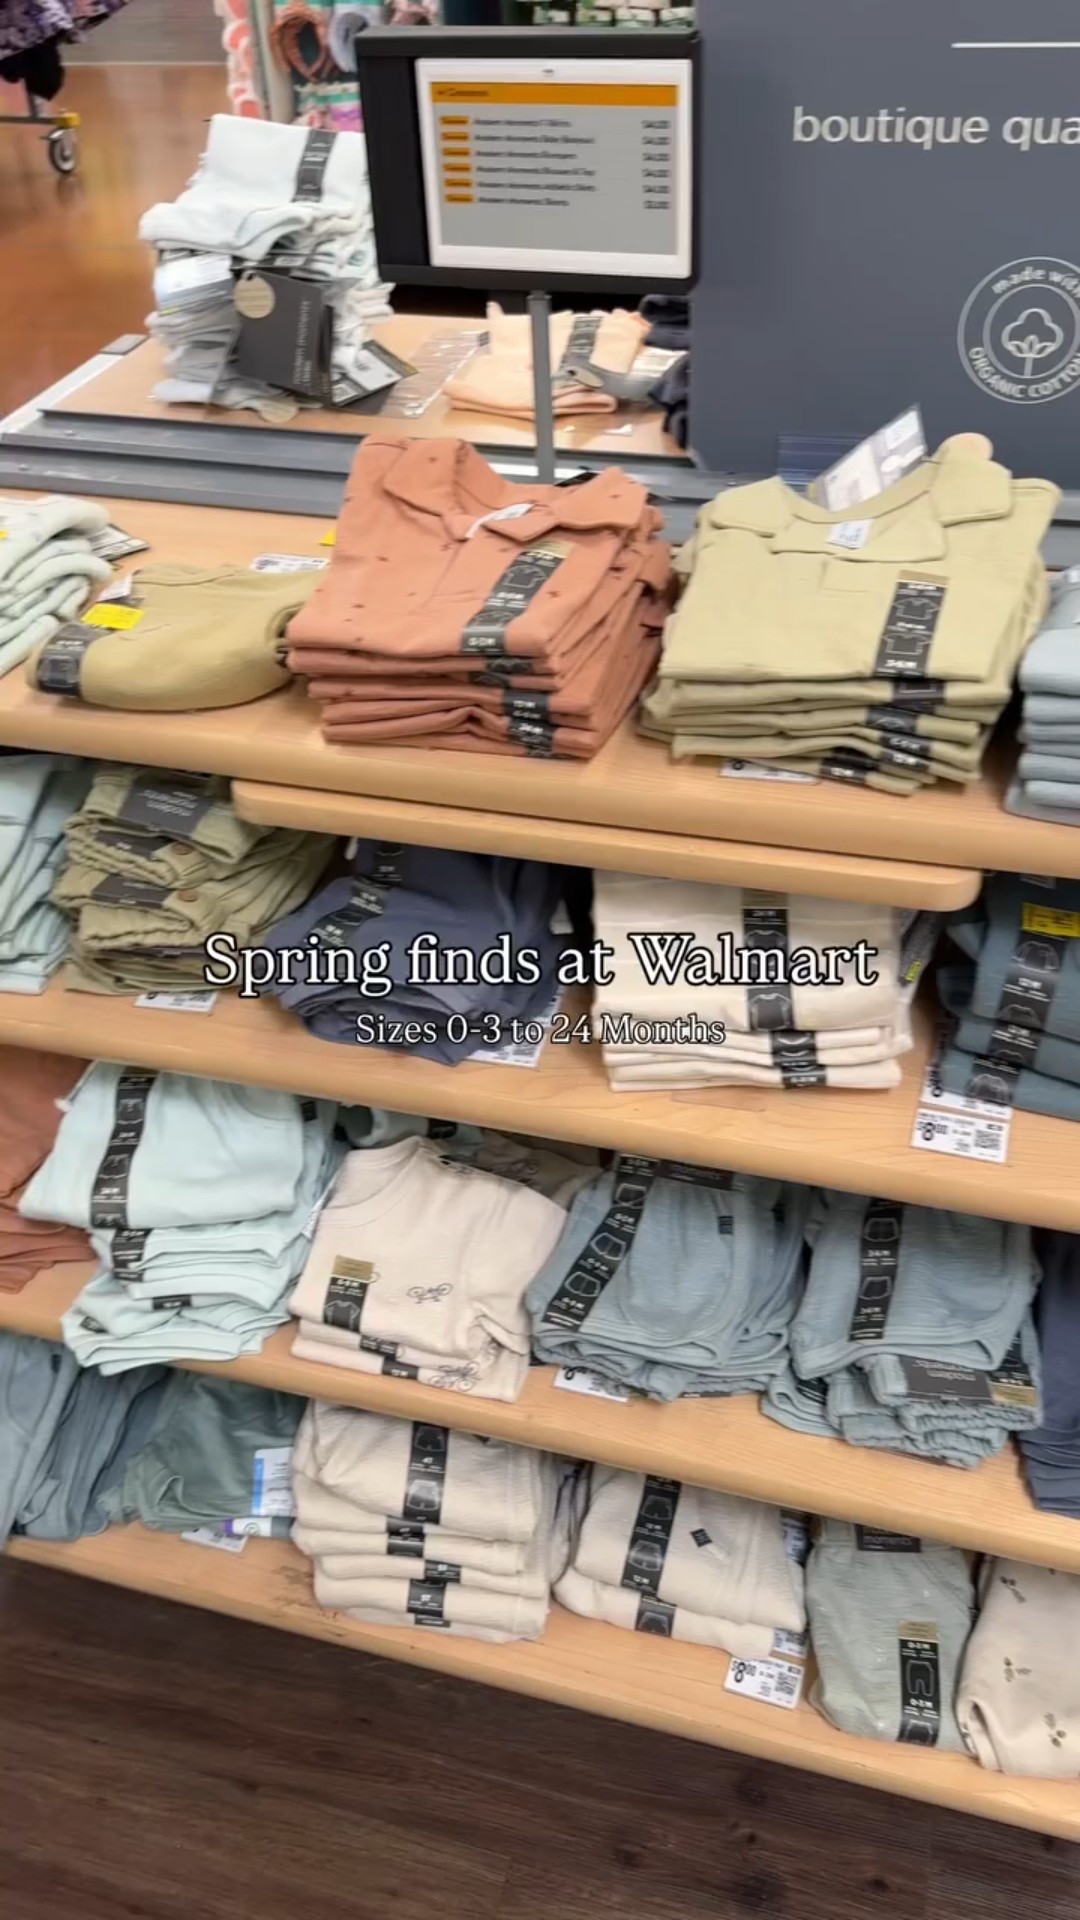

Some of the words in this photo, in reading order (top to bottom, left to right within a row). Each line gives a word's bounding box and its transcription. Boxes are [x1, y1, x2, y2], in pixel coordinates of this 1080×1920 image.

[793, 106, 990, 150] boutique
[1002, 115, 1080, 151] qua
[992, 266, 1046, 294] made
[968, 347, 1028, 398] ORGANIC
